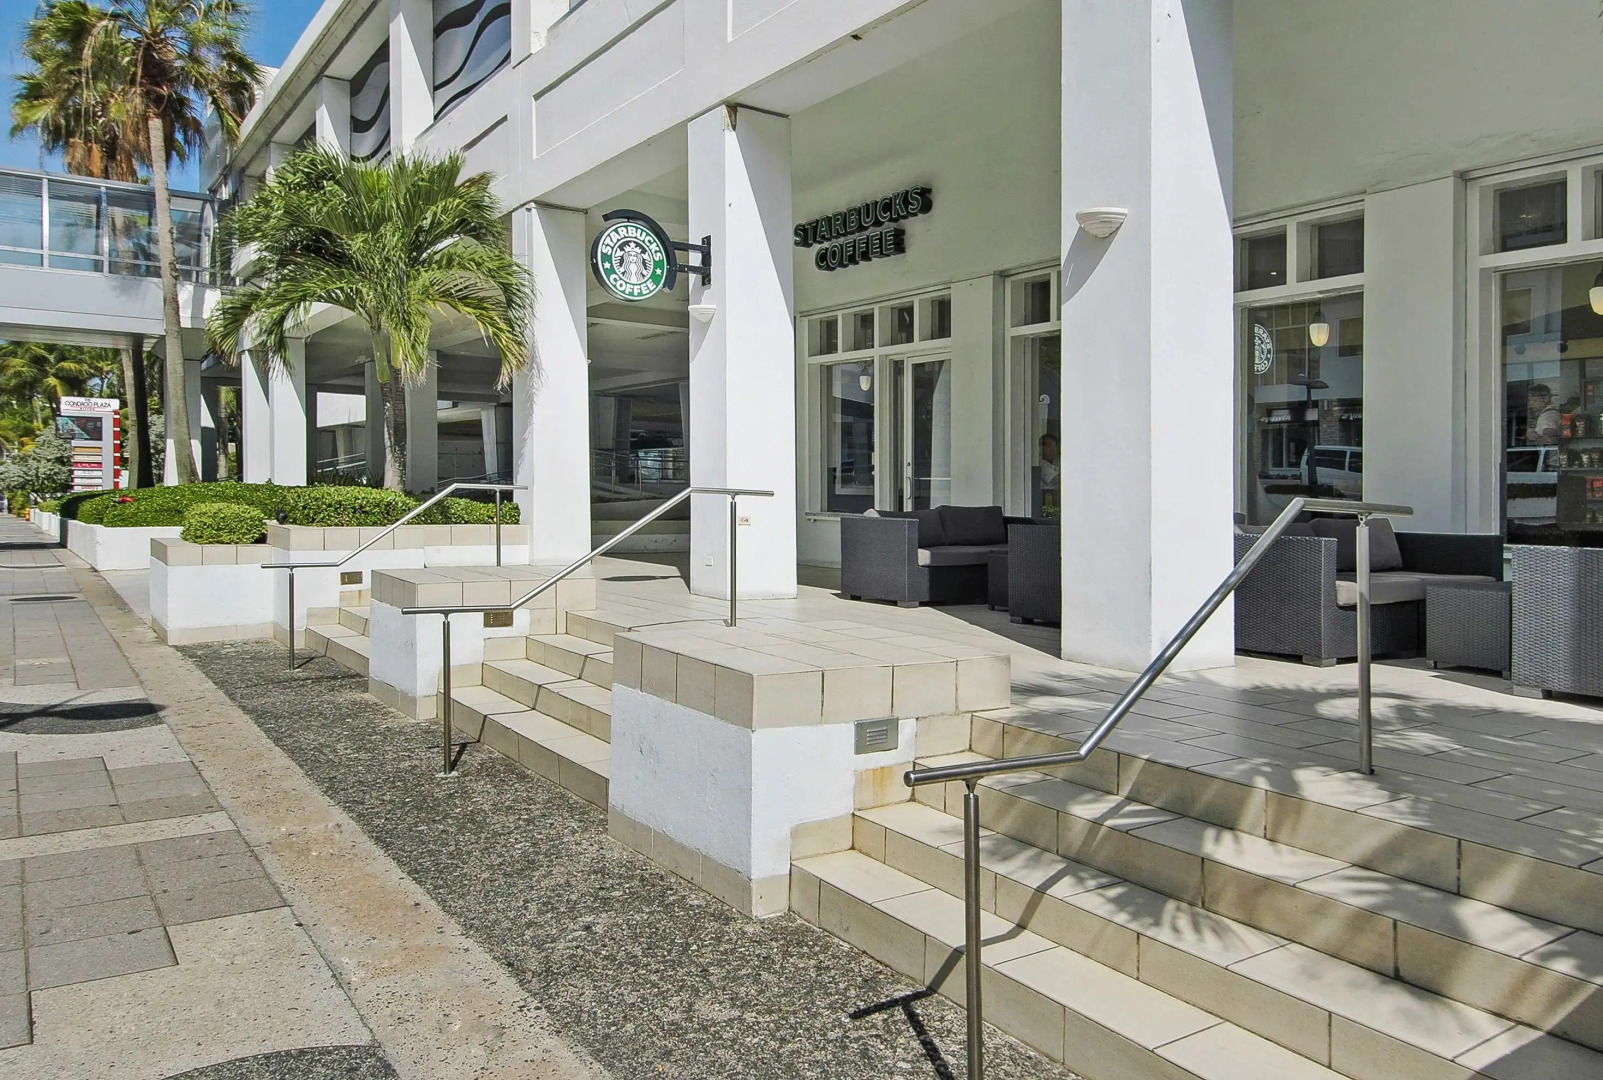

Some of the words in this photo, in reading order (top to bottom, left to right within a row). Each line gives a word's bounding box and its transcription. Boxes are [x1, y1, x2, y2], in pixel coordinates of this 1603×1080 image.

[794, 185, 929, 247] STARBUCKS
[602, 226, 662, 261] STARBUCKS
[815, 228, 902, 270] COFFEE
[609, 274, 656, 296] COFFEE
